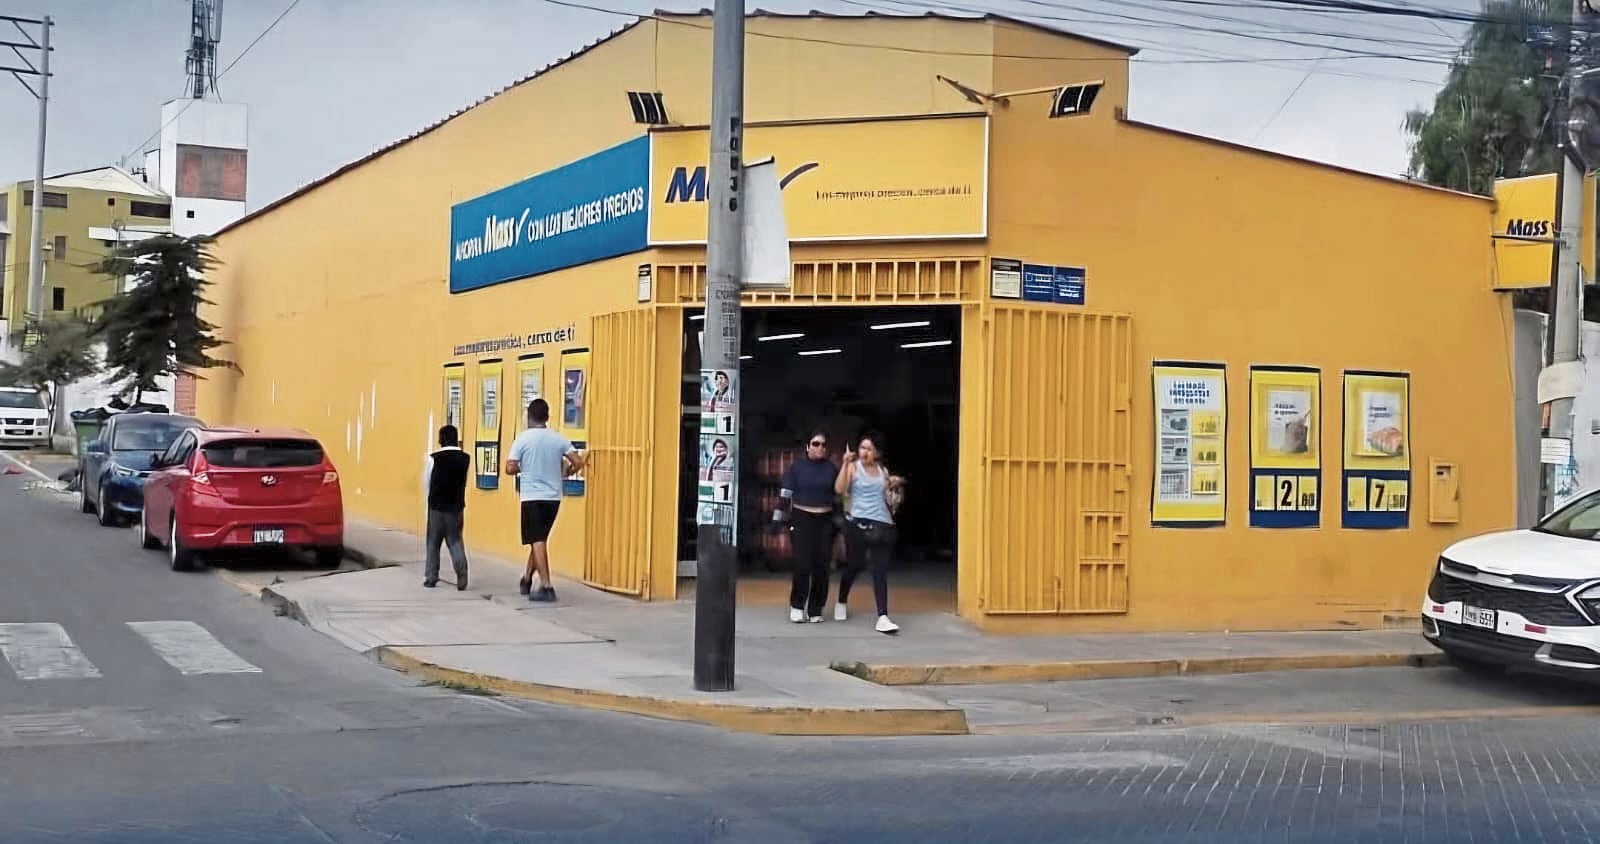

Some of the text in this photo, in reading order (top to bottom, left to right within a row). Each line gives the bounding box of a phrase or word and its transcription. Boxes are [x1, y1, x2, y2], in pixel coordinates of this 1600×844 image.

[484, 215, 515, 254] Mass
[561, 200, 601, 233] MEJORES
[603, 187, 643, 222] PRECIOS
[1506, 218, 1549, 236] Mass
[722, 416, 732, 432] 1
[720, 484, 730, 501] 1
[1281, 480, 1292, 507] 2
[1375, 484, 1385, 508] 7
